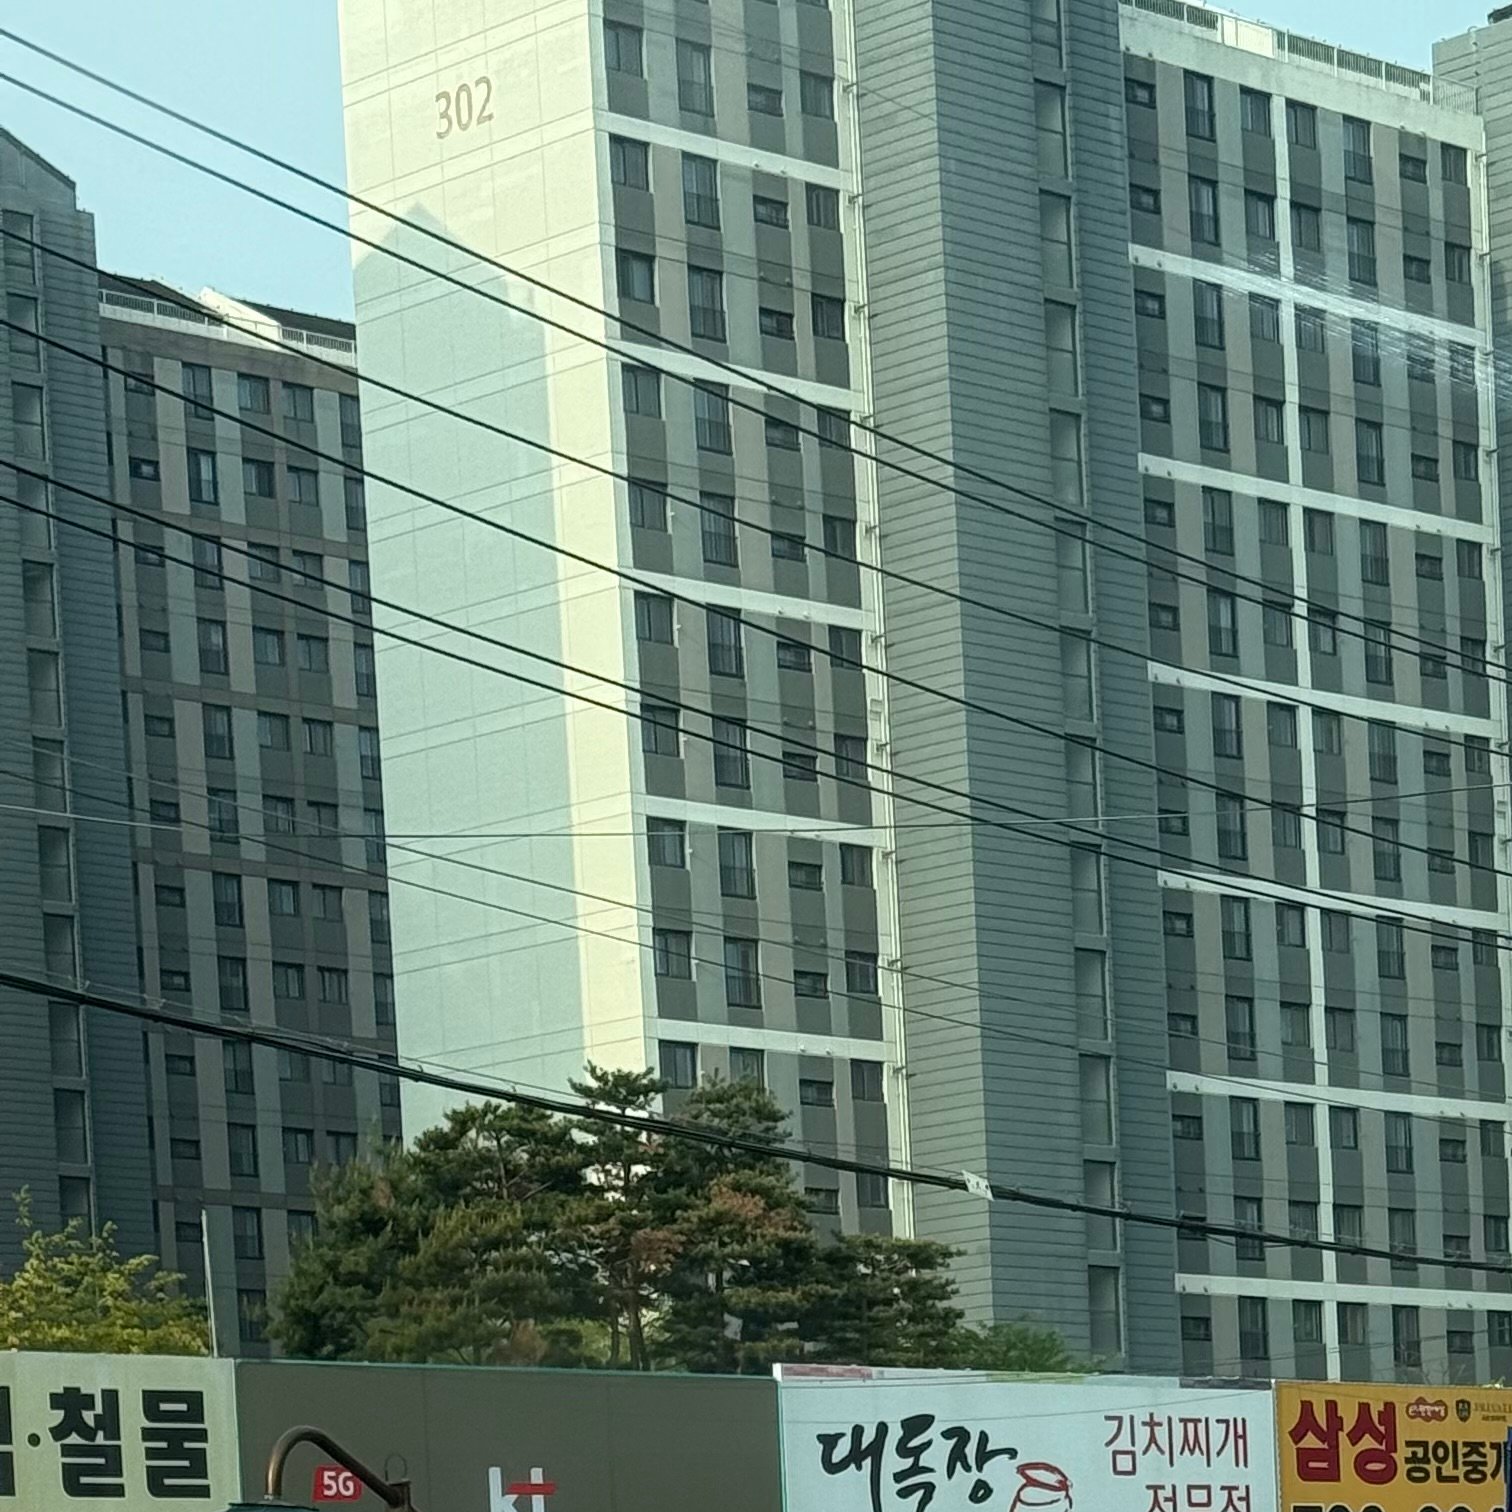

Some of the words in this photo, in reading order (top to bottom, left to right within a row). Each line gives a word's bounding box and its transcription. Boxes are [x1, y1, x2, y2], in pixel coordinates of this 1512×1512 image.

[434, 76, 494, 139] 302
[0, 1386, 211, 1498] ·철물
[1103, 1411, 1250, 1477] 김치찌개
[1288, 1400, 1398, 1484] 삼성
[323, 1471, 354, 1497] 5G
